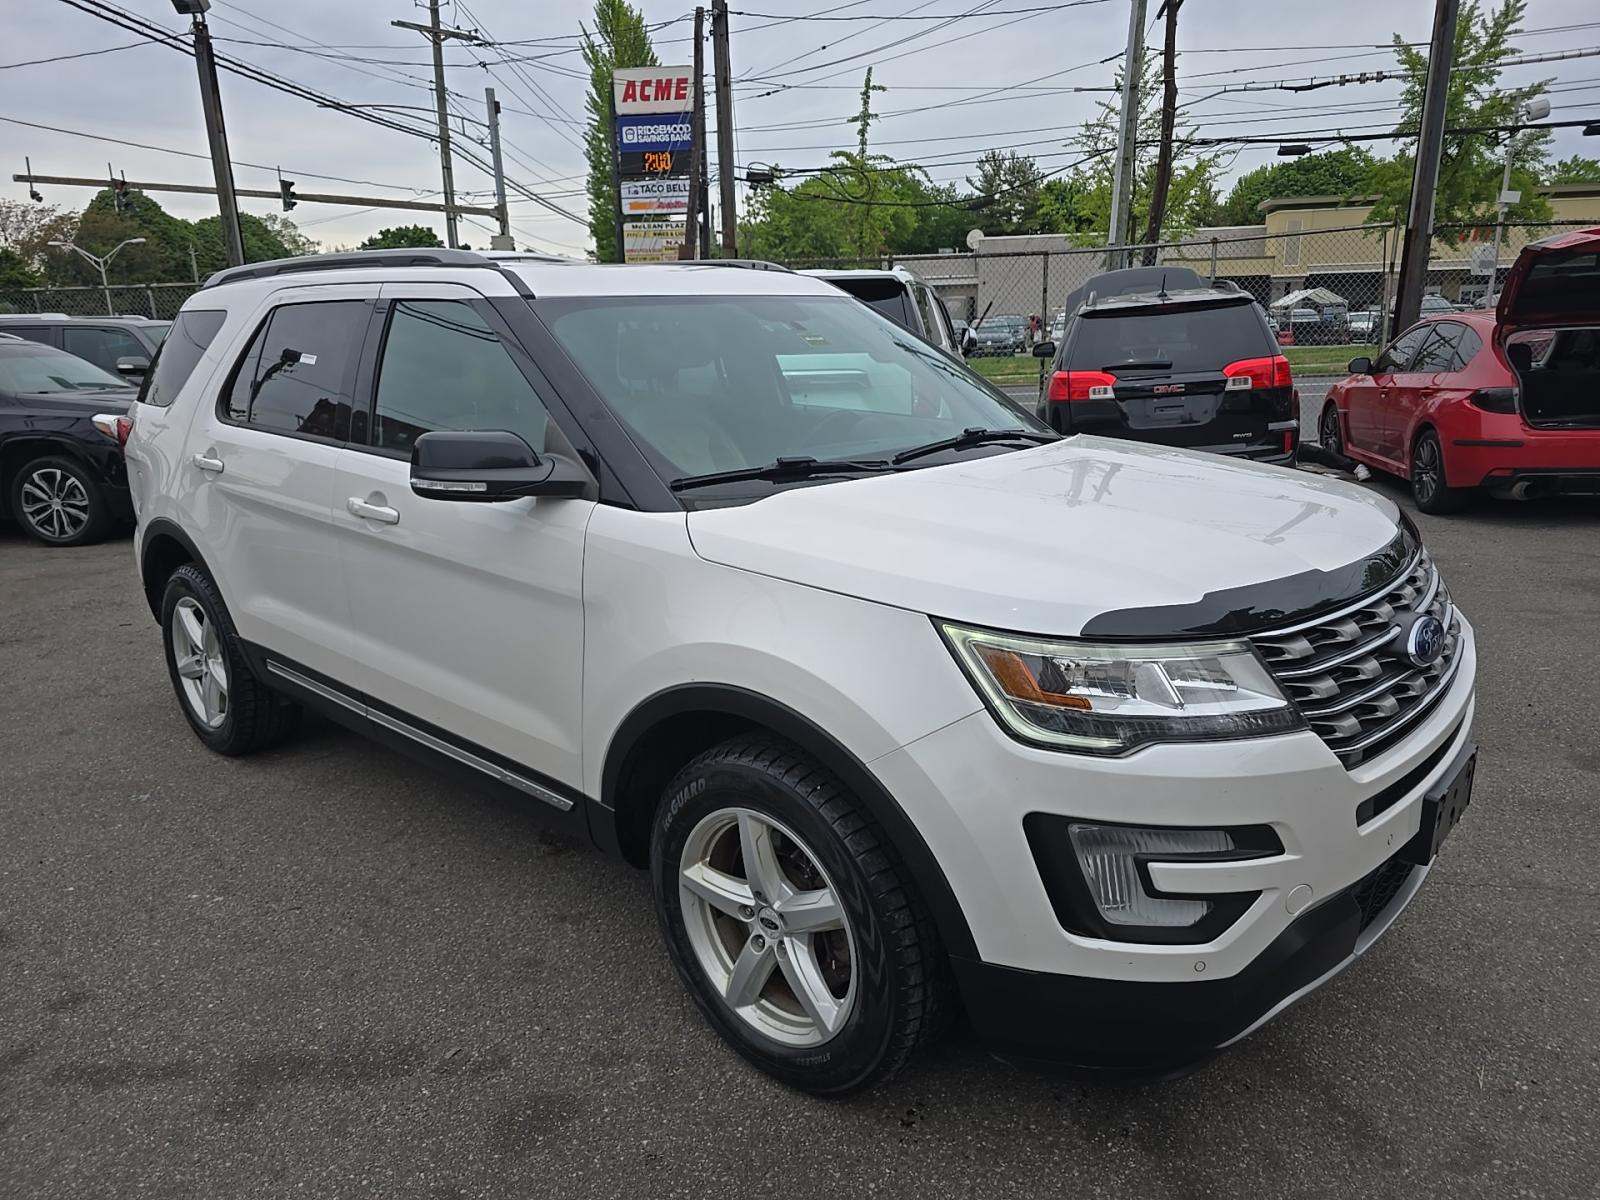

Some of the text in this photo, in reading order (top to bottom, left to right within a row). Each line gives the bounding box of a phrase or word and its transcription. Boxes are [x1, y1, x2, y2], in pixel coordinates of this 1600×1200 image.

[622, 78, 689, 103] ACME
[637, 123, 692, 135] RIDGEWOOD
[638, 133, 692, 143] SAVINGS BANK
[639, 183, 689, 194] TACO BELL
[1152, 383, 1185, 393] GMC
